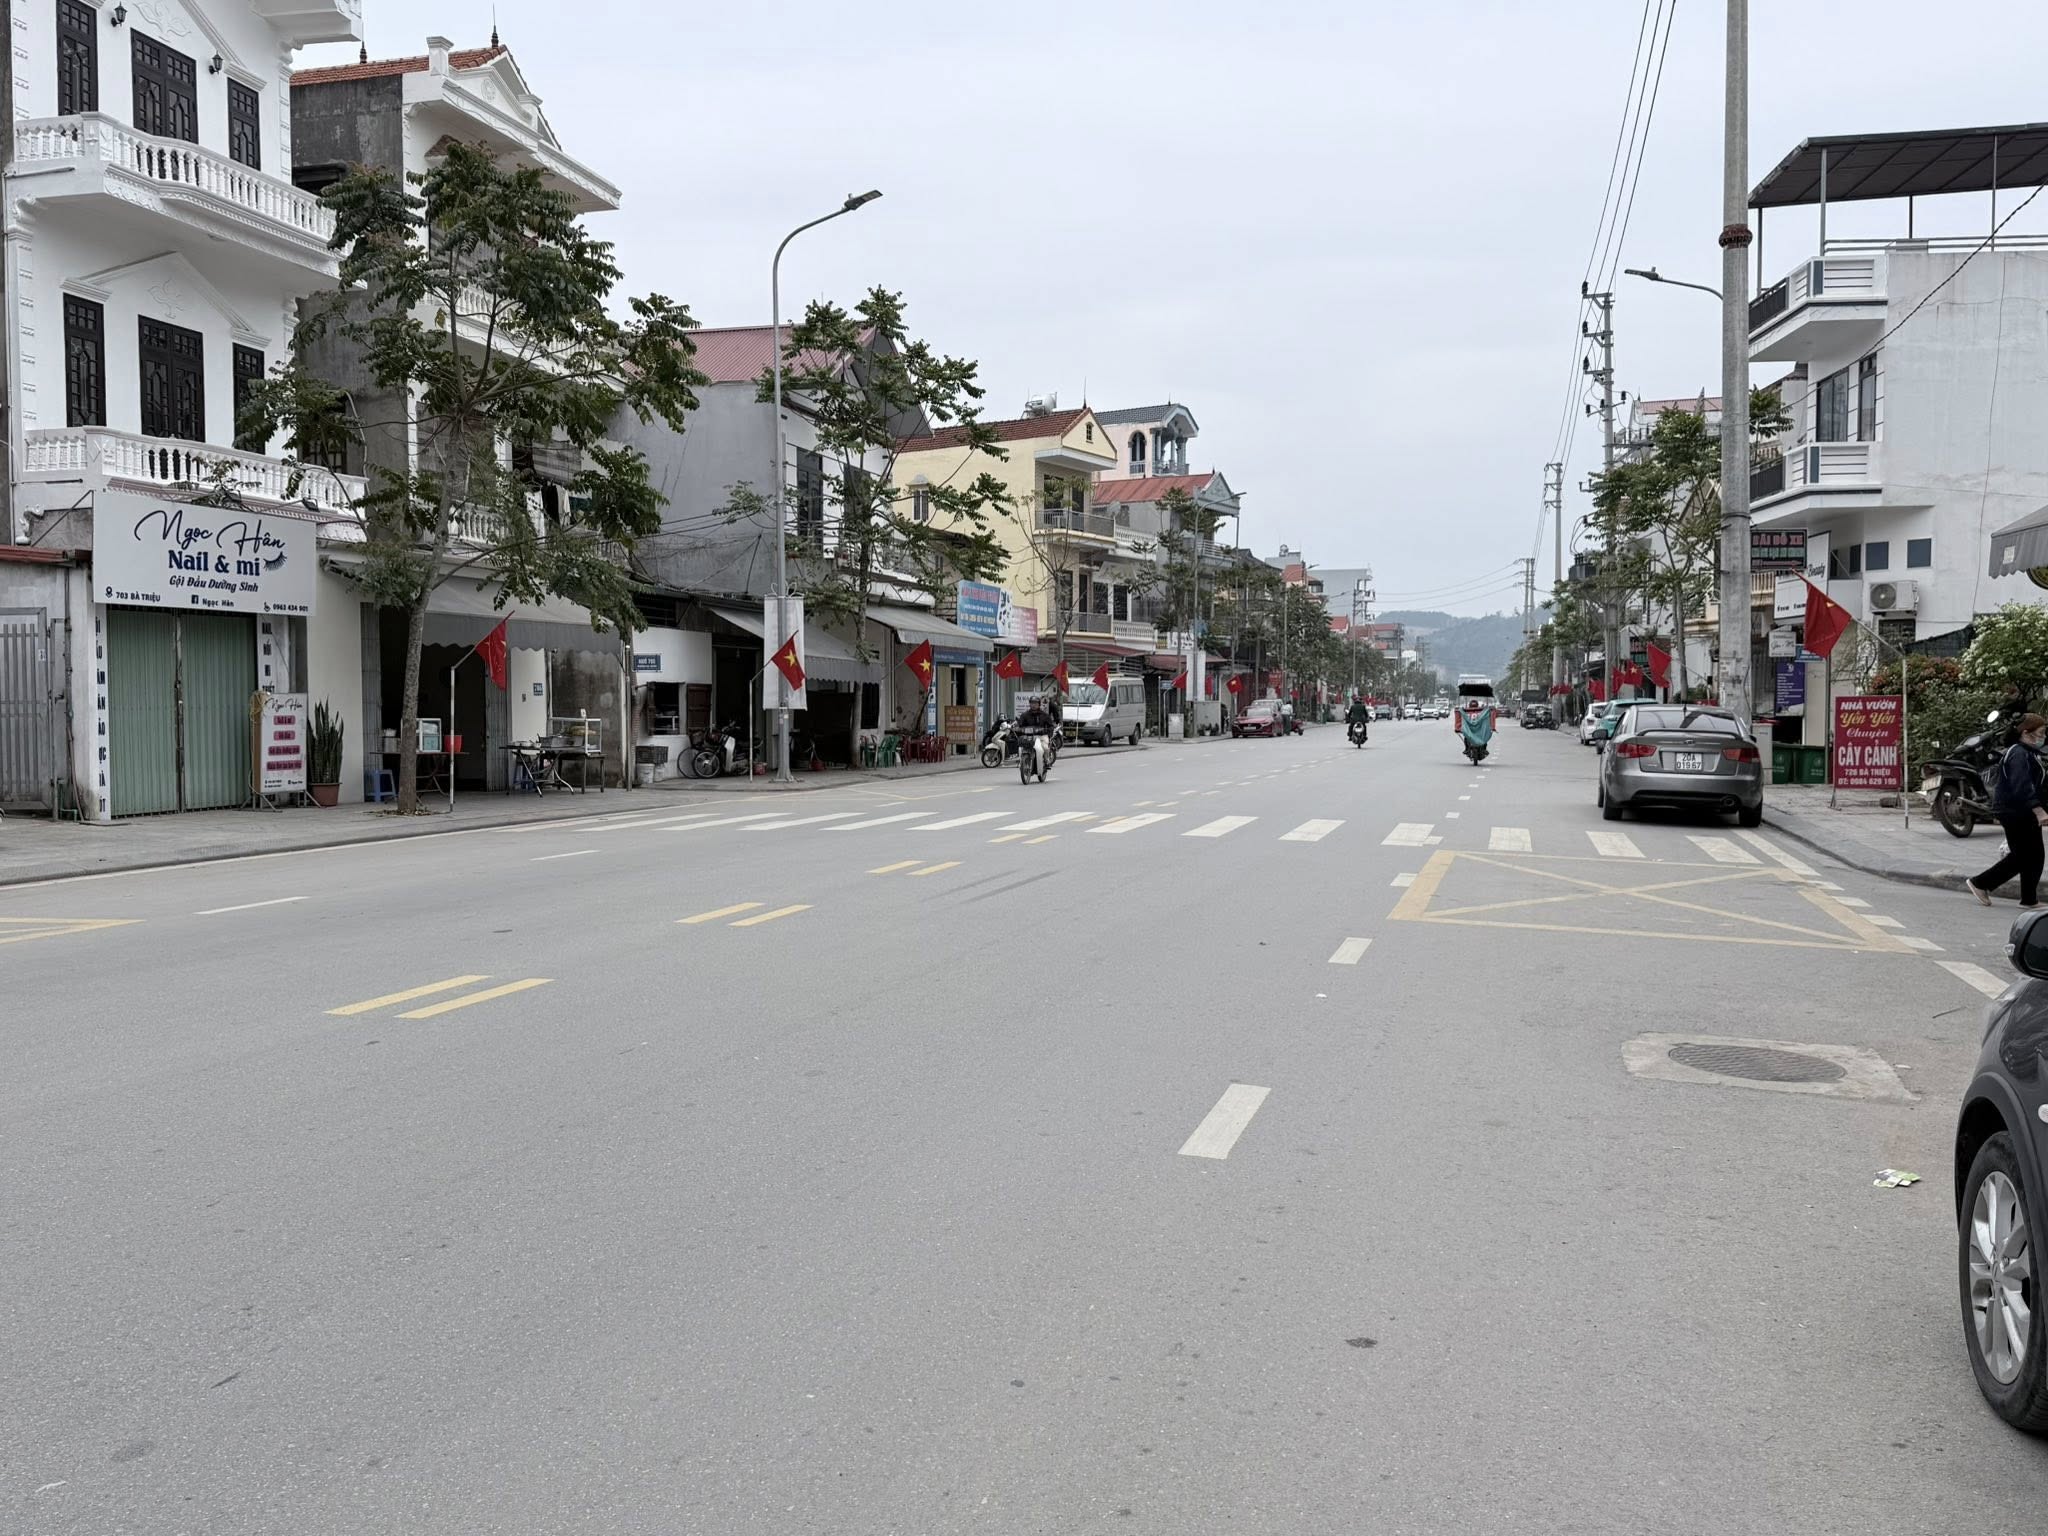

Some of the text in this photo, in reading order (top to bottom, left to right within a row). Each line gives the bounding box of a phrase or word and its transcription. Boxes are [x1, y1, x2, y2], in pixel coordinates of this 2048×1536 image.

[216, 519, 285, 556] Hân
[168, 550, 260, 576] Nail & mi
[115, 590, 161, 603] 703 BÀ TRIỆU
[1840, 699, 1863, 710] NHÀ
[1840, 711, 1896, 727] Yên Yên
[1838, 739, 1897, 766] CÂY CẢNH
